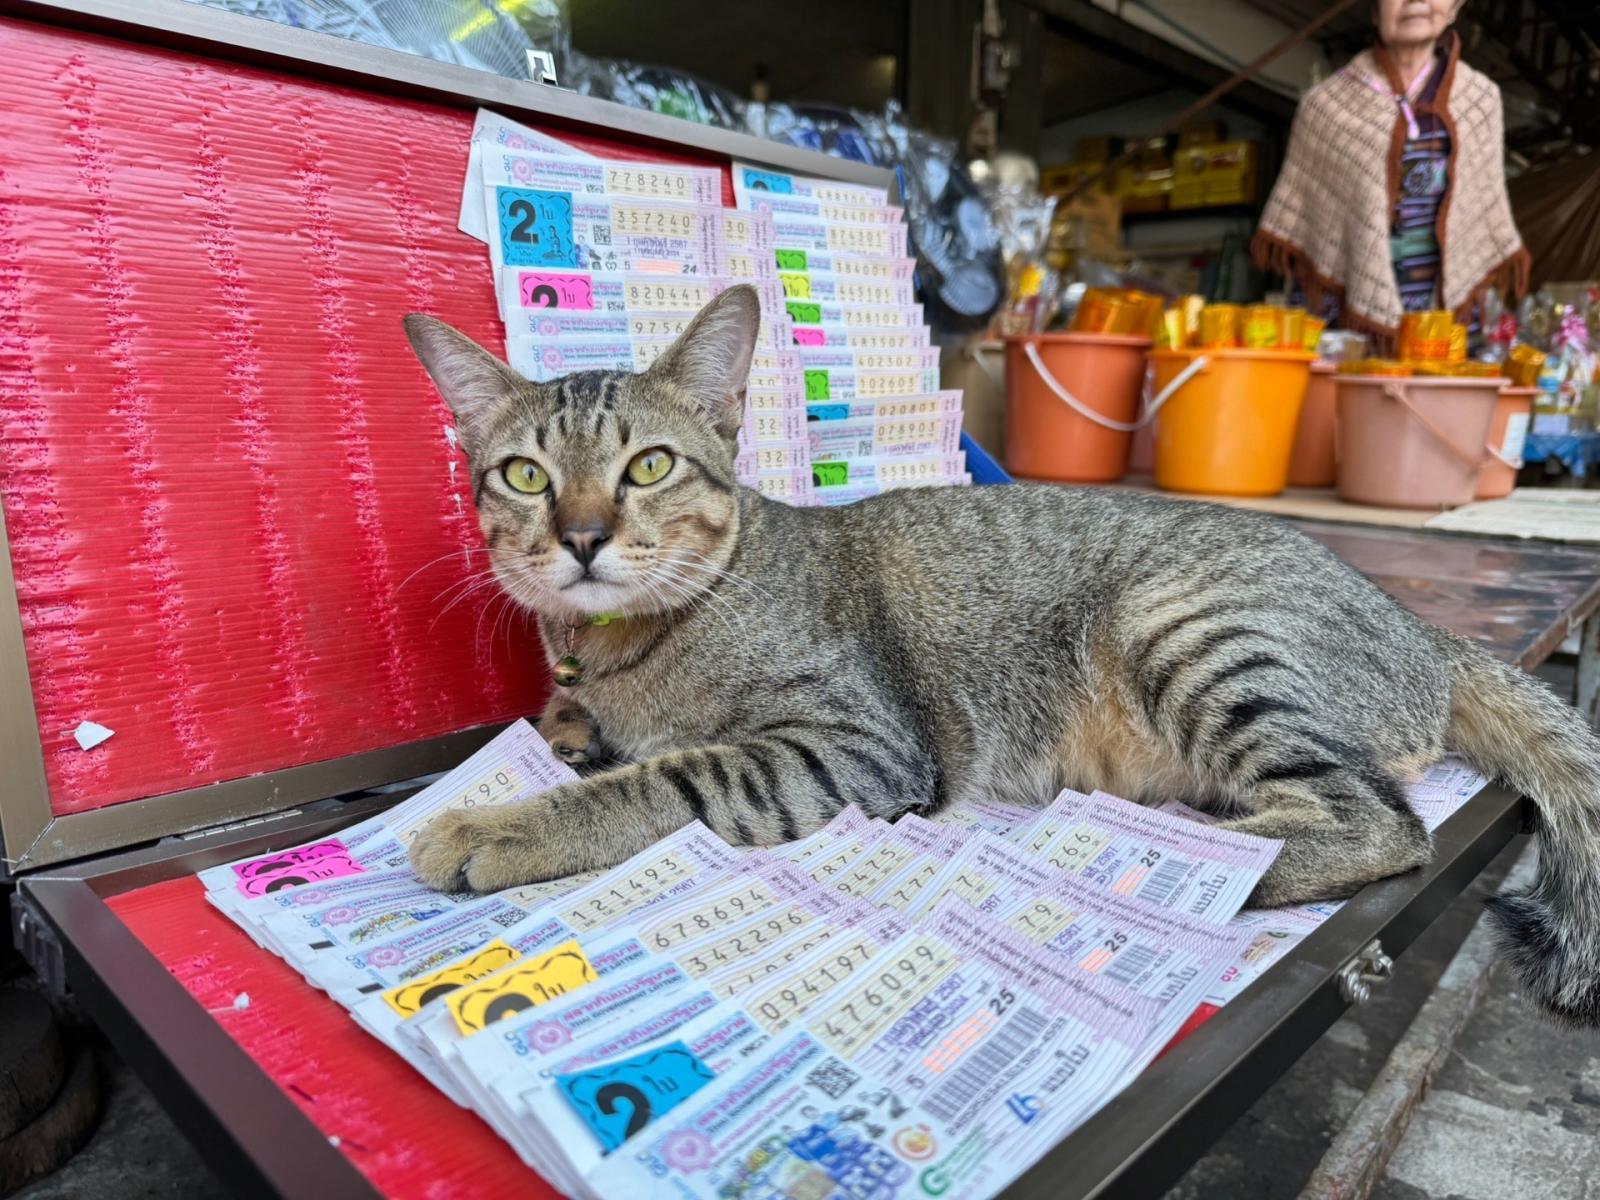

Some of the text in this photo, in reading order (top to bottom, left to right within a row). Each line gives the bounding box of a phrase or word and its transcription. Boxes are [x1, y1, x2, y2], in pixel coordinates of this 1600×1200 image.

[609, 169, 685, 190] 778240
[508, 199, 540, 244] 2
[617, 210, 691, 229] 357240
[682, 264, 697, 274] 24
[631, 287, 701, 301] 820441
[635, 322, 683, 335] 9756
[1140, 849, 1162, 868] 25
[572, 857, 678, 921] 121493
[655, 889, 764, 948] 678694
[689, 912, 802, 972] 342296
[1104, 932, 1128, 952] 25
[760, 944, 870, 1021] 094197
[825, 945, 934, 1037] 476099
[906, 987, 1016, 1090] 5 25
